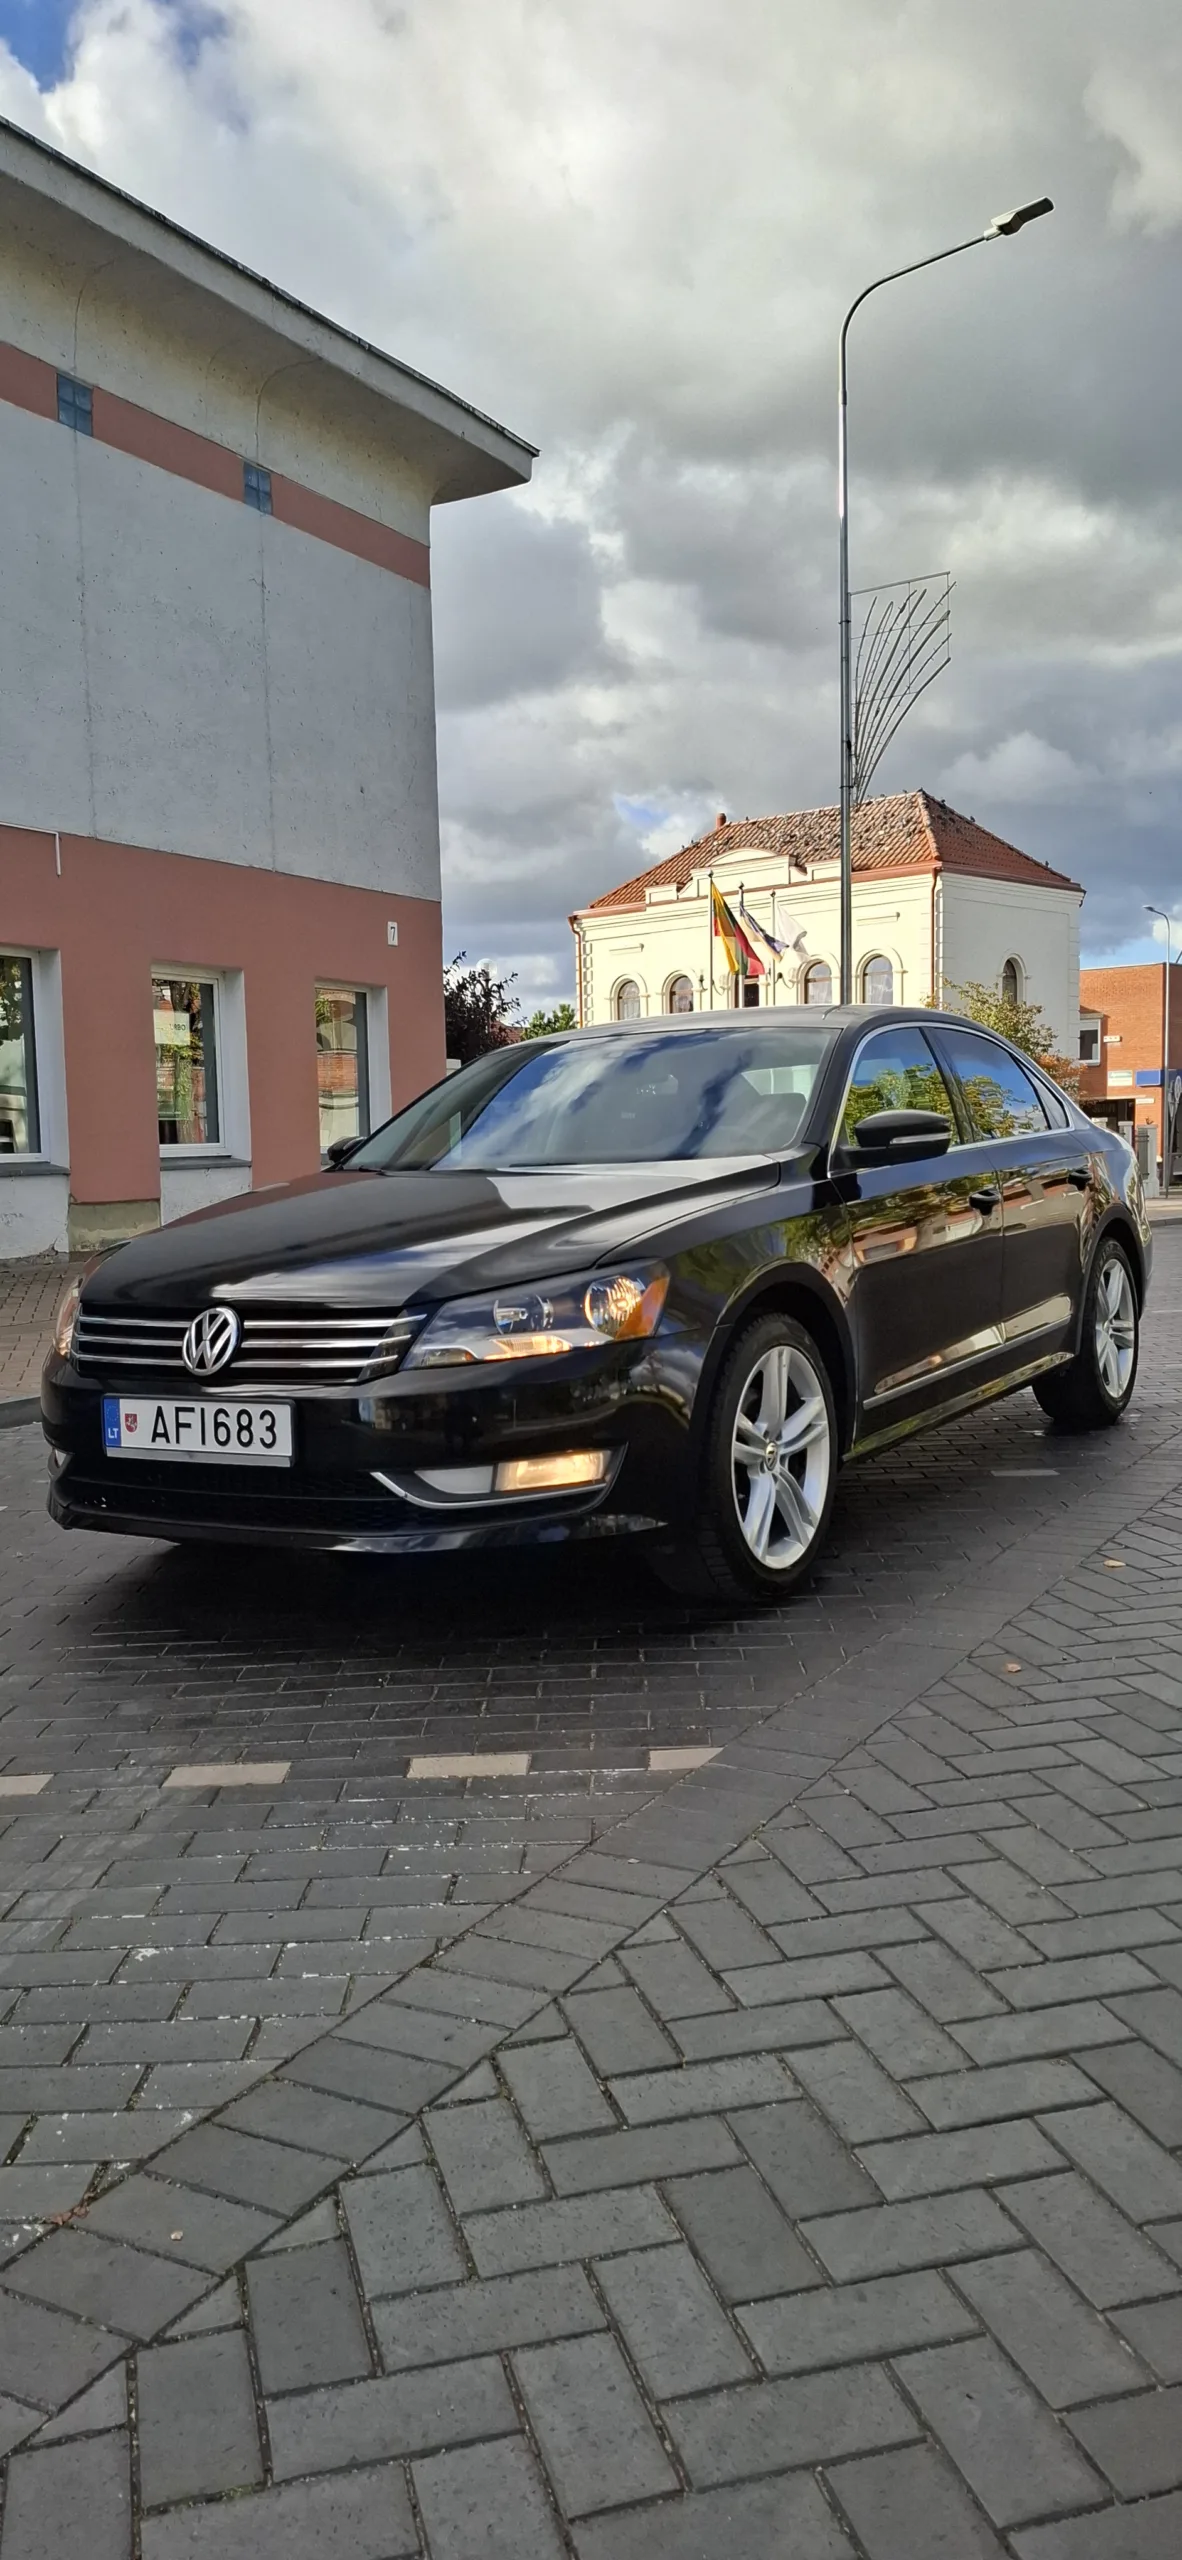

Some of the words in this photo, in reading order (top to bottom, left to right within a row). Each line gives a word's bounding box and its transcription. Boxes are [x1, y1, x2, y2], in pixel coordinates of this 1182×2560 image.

[390, 926, 396, 941] 7
[184, 1307, 240, 1375] VW
[107, 1427, 119, 1439] LT
